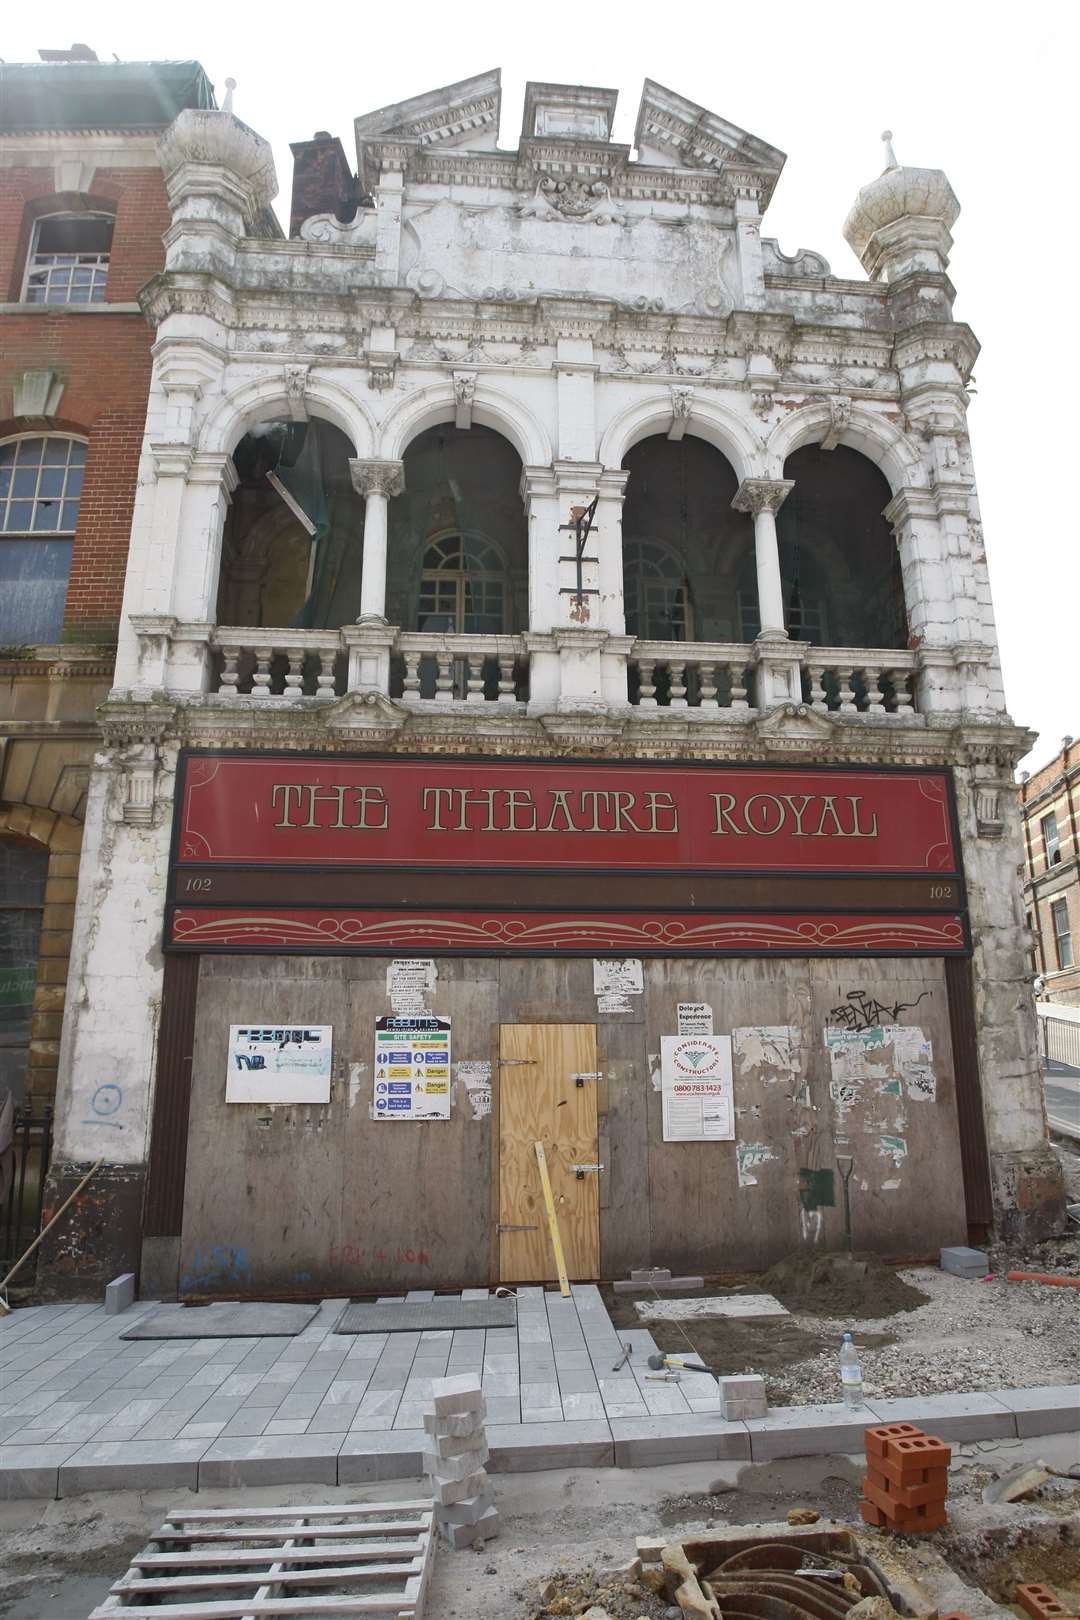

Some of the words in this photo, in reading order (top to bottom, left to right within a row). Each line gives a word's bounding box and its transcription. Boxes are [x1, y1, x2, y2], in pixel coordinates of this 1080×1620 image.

[271, 784, 389, 830] THE
[423, 787, 679, 833] THEATRE
[707, 793, 878, 838] ROYAL
[183, 877, 212, 892] 102
[929, 886, 952, 899] 102
[674, 1040, 719, 1056] CONSIDERATE
[673, 1059, 720, 1075] CONSTRUCTORS
[673, 1084, 691, 1092] 0800
[692, 1084, 705, 1092] 783
[706, 1084, 721, 1092] 1423
